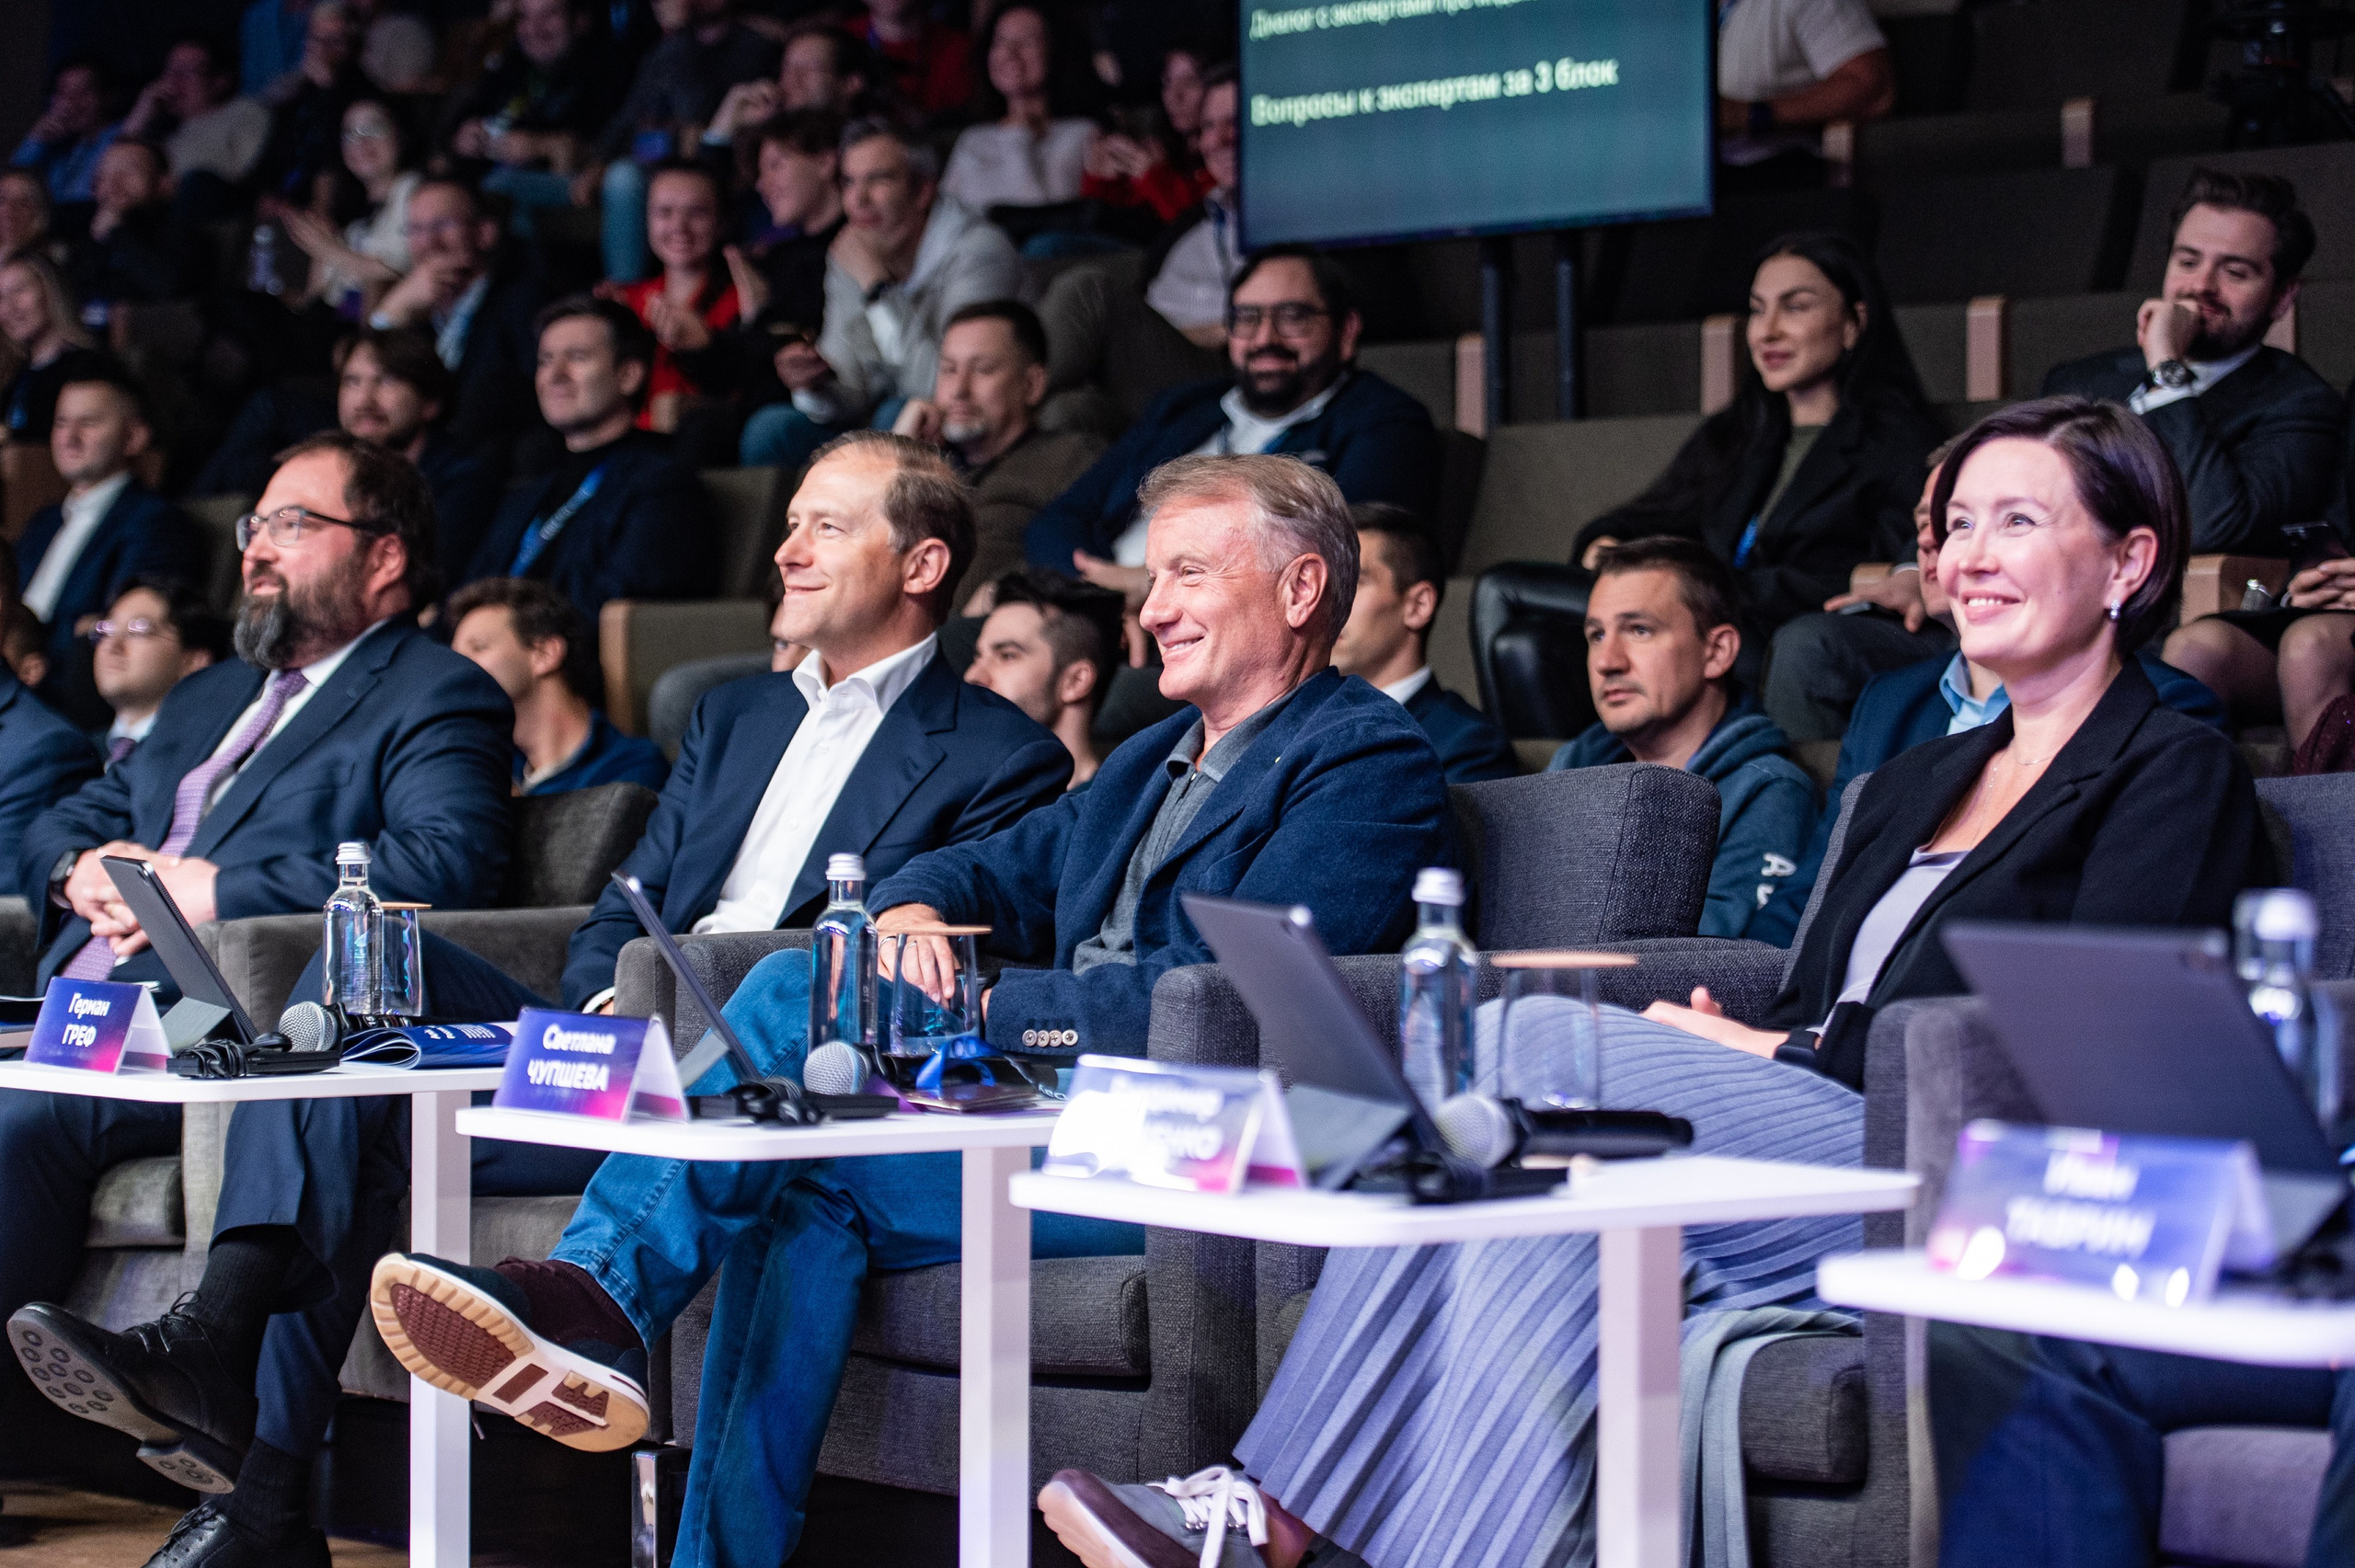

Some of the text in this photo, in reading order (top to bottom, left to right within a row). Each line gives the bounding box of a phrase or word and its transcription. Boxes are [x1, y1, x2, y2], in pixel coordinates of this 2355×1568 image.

[1249, 7, 1315, 40] Диалог
[1315, 6, 1332, 29] с
[1251, 57, 1620, 127] Вопросы к экспертам за 3 блок
[68, 992, 111, 1019] Герман
[62, 1023, 98, 1047] ГРЕФ
[543, 1022, 617, 1055] Светлана
[527, 1058, 610, 1092] ЧУПШЕВА
